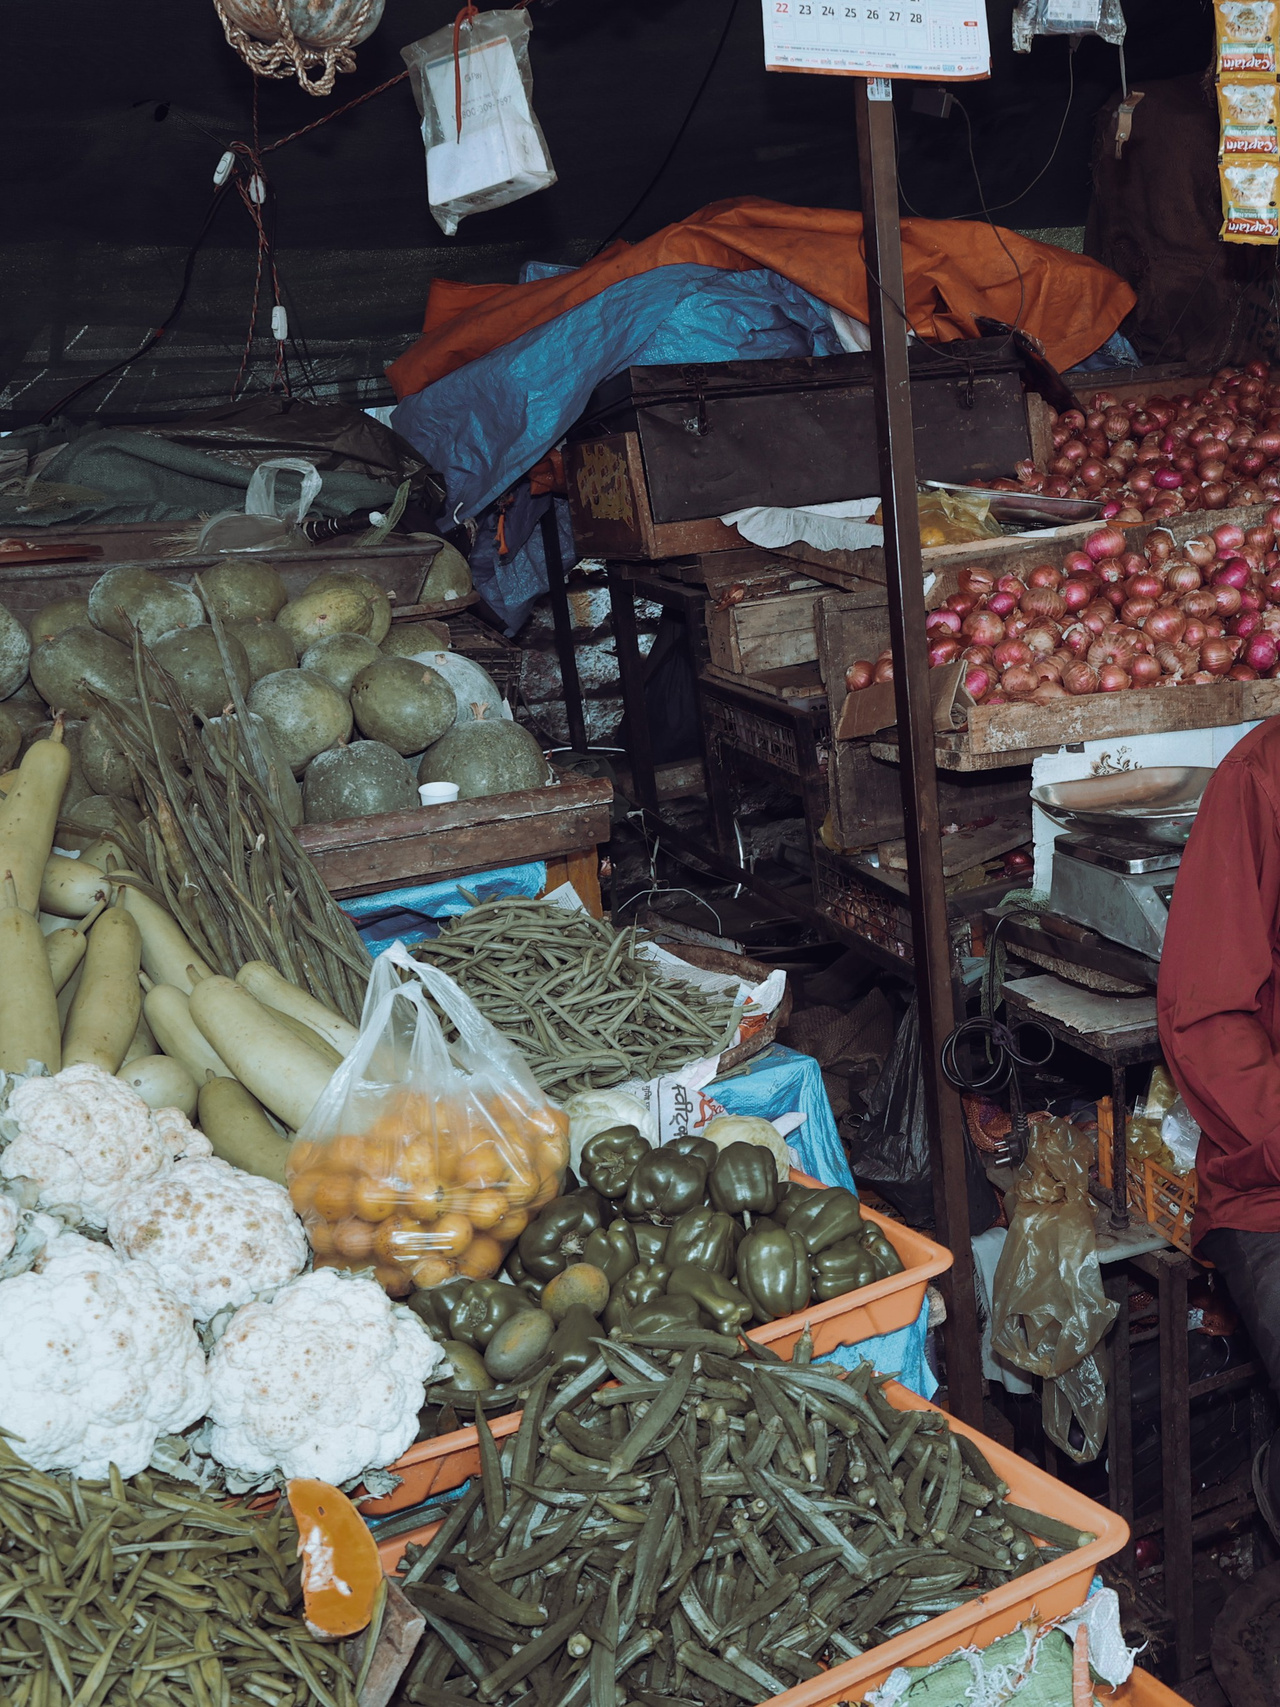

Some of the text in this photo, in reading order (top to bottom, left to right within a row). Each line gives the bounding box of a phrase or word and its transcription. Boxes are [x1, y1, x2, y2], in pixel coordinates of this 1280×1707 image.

[776, 3, 923, 23] 22 23 24 25 26 27 28
[1224, 56, 1270, 71] Captain
[1226, 138, 1273, 152] Captain
[1228, 221, 1274, 234] Captain
